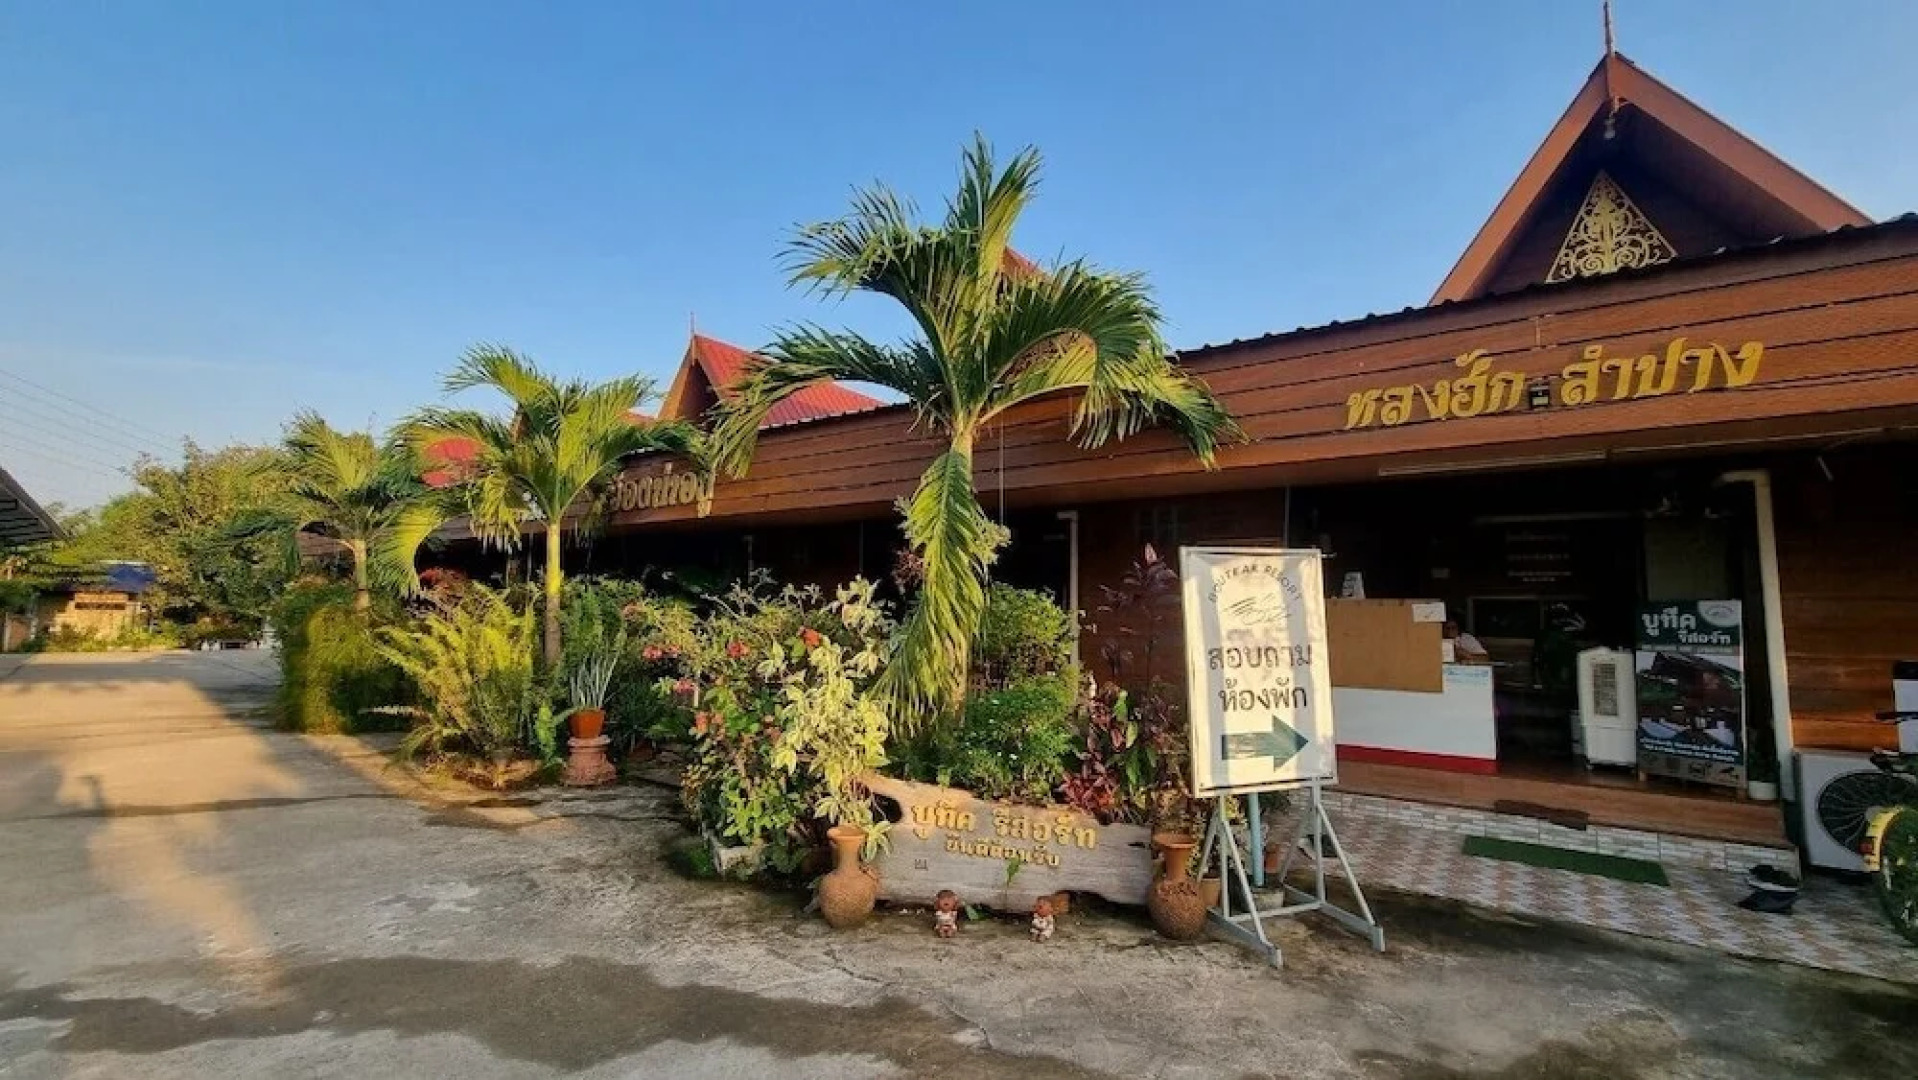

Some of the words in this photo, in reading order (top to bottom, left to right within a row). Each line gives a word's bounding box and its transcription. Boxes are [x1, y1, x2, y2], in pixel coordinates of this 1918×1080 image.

[1345, 348, 1526, 430] หลงฮัก
[1208, 644, 1313, 670] สอบถาม
[1218, 677, 1308, 712] ห้องพัก
